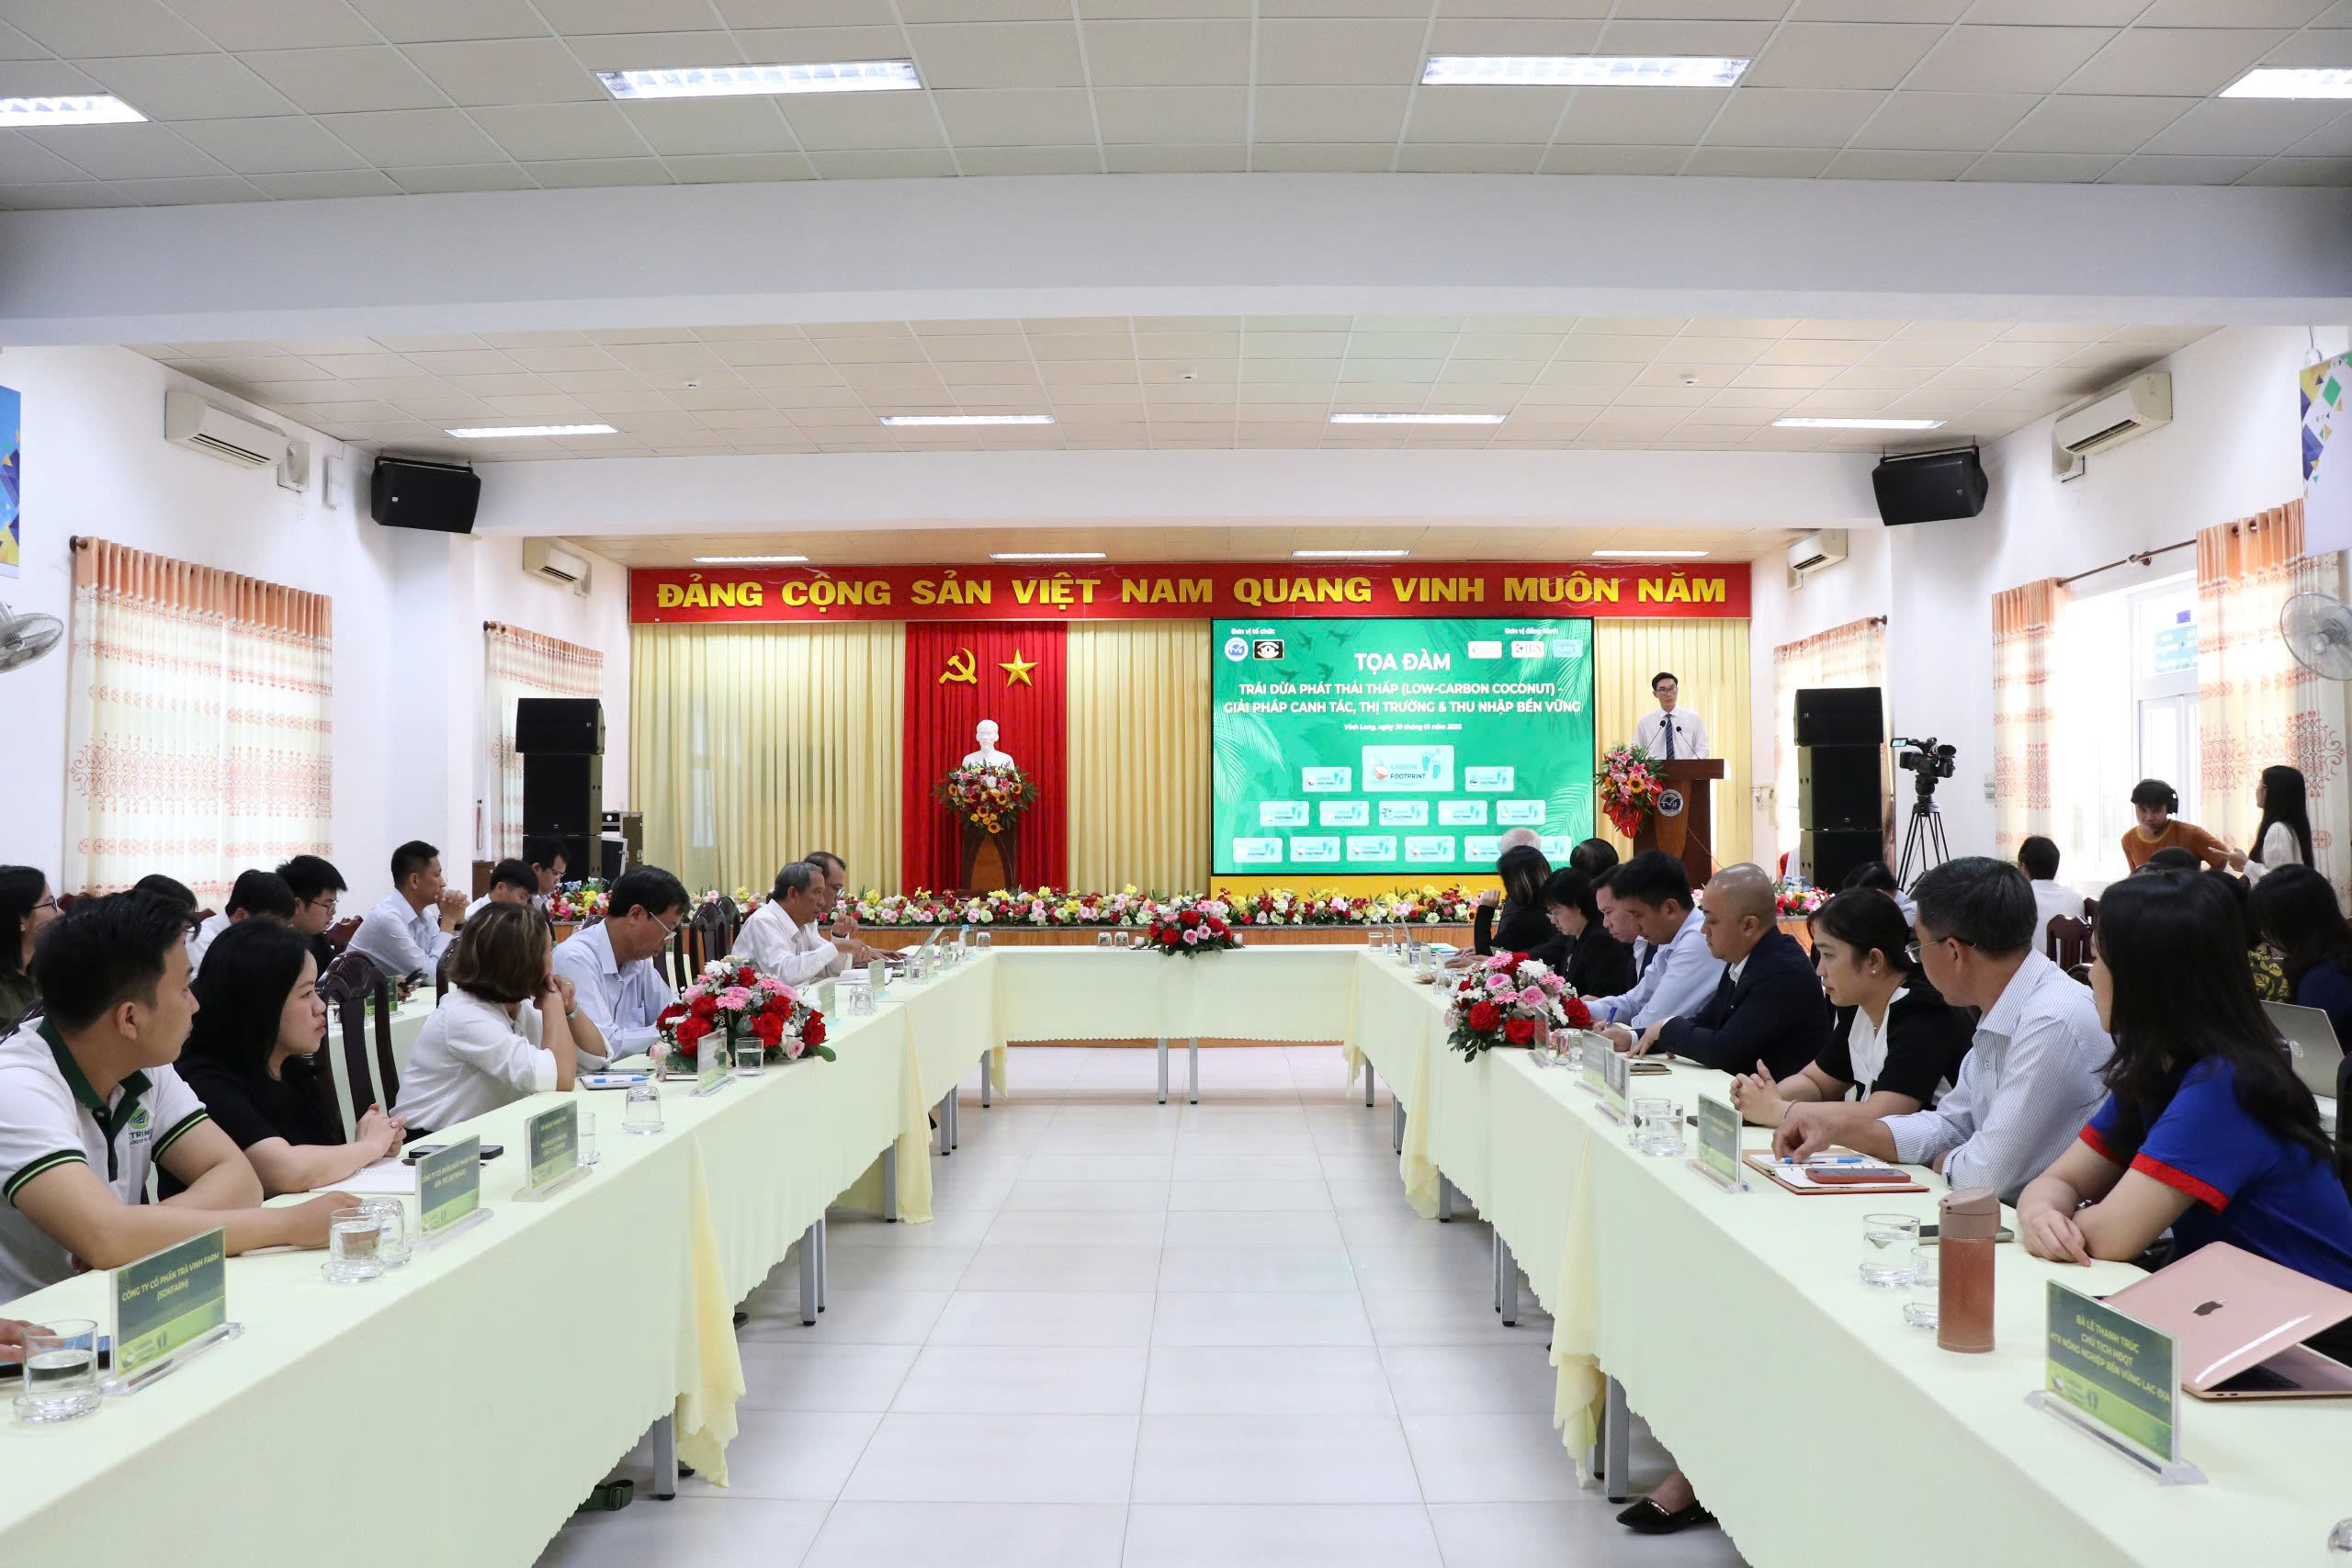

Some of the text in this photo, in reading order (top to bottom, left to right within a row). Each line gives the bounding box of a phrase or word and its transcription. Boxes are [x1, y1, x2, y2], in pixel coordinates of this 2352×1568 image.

[657, 570, 1726, 613] ĐẢNG CỘNG SẢN VIỆT NAM QUANG VINH MUÔN NĂM
[1353, 648, 1451, 675] TỌA ĐÀM
[1238, 681, 1267, 694] TRÁI
[1270, 681, 1297, 694] DỪA
[1299, 681, 1332, 694] PHÁT
[1334, 680, 1363, 694] THẢI
[1401, 682, 1490, 696] (LOW-CARBON
[1492, 682, 1555, 696] COCONUT)
[1223, 698, 1250, 713] GIẢI
[1252, 699, 1288, 713] PHÁP
[1290, 701, 1327, 713] CANH
[1329, 699, 1357, 715] TÁC,
[1359, 701, 1380, 716] THỊ
[1382, 698, 1435, 713] TRƯỜNG
[1438, 701, 1447, 713] &
[1449, 701, 1476, 713] THU
[1478, 698, 1514, 716] NHẬP
[1544, 698, 1581, 713] VỮNG
[121, 1286, 141, 1301] CÔNG
[141, 1283, 150, 1293] TY
[189, 1258, 204, 1272] VINH
